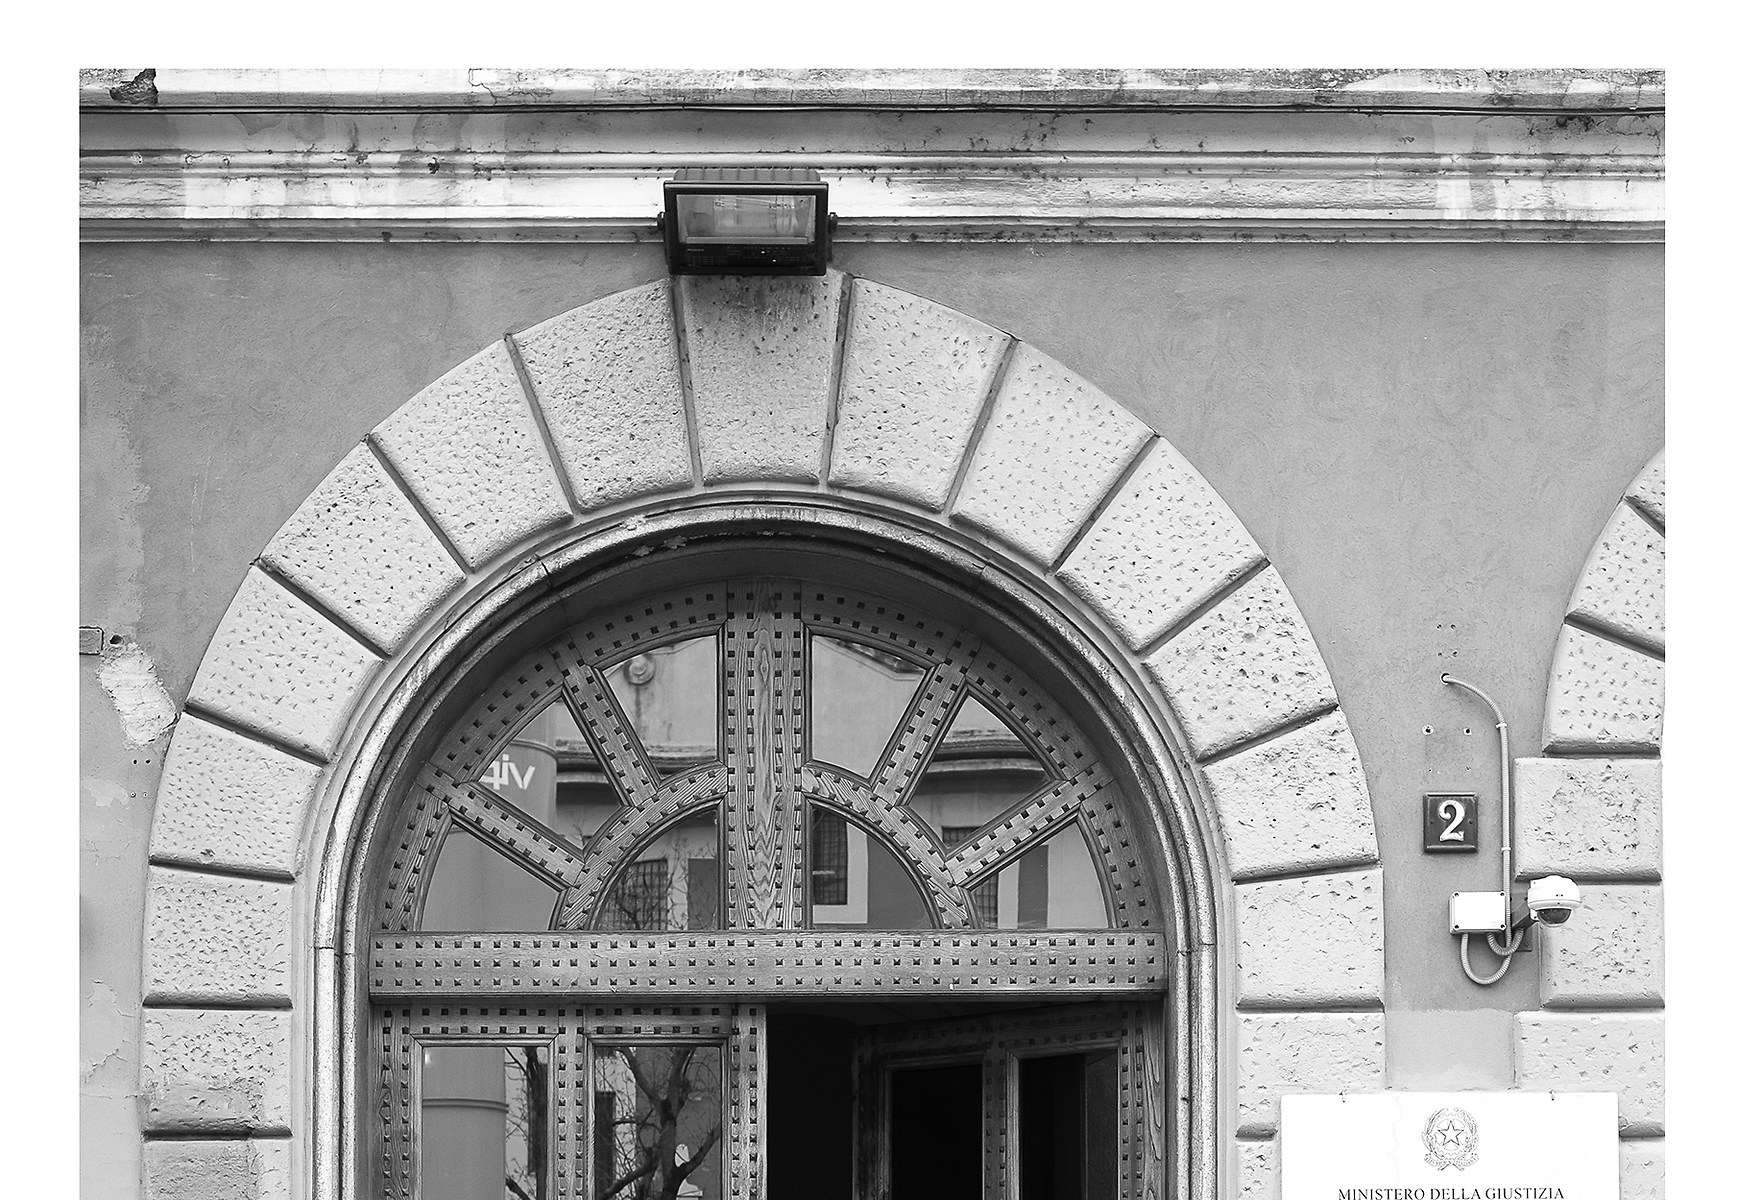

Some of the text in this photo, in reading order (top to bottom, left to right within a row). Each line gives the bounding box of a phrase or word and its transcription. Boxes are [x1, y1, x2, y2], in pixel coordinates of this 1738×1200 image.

[1438, 799, 1466, 842] 2
[1338, 1187, 1565, 1200] MINISTERO DELLA GIUSTIZIA
